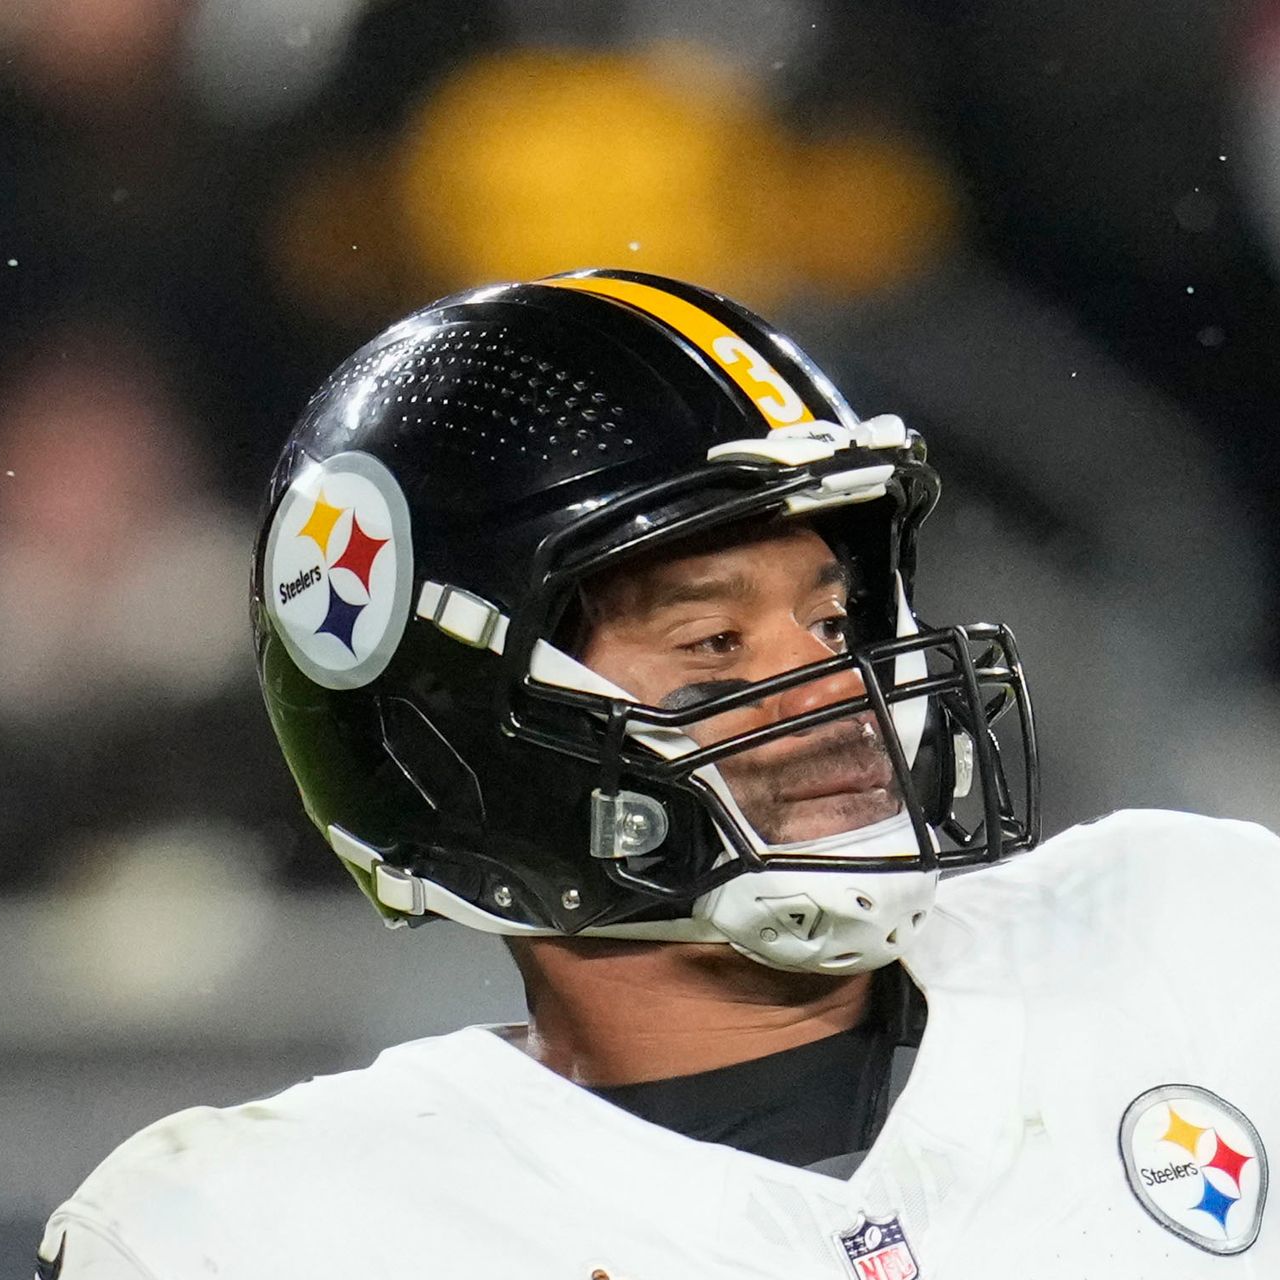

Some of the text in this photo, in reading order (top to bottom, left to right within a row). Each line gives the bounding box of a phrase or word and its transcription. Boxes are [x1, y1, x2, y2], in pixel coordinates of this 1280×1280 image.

[711, 335, 805, 424] 3
[280, 564, 322, 606] Steelers
[1140, 1160, 1199, 1187] Steelers
